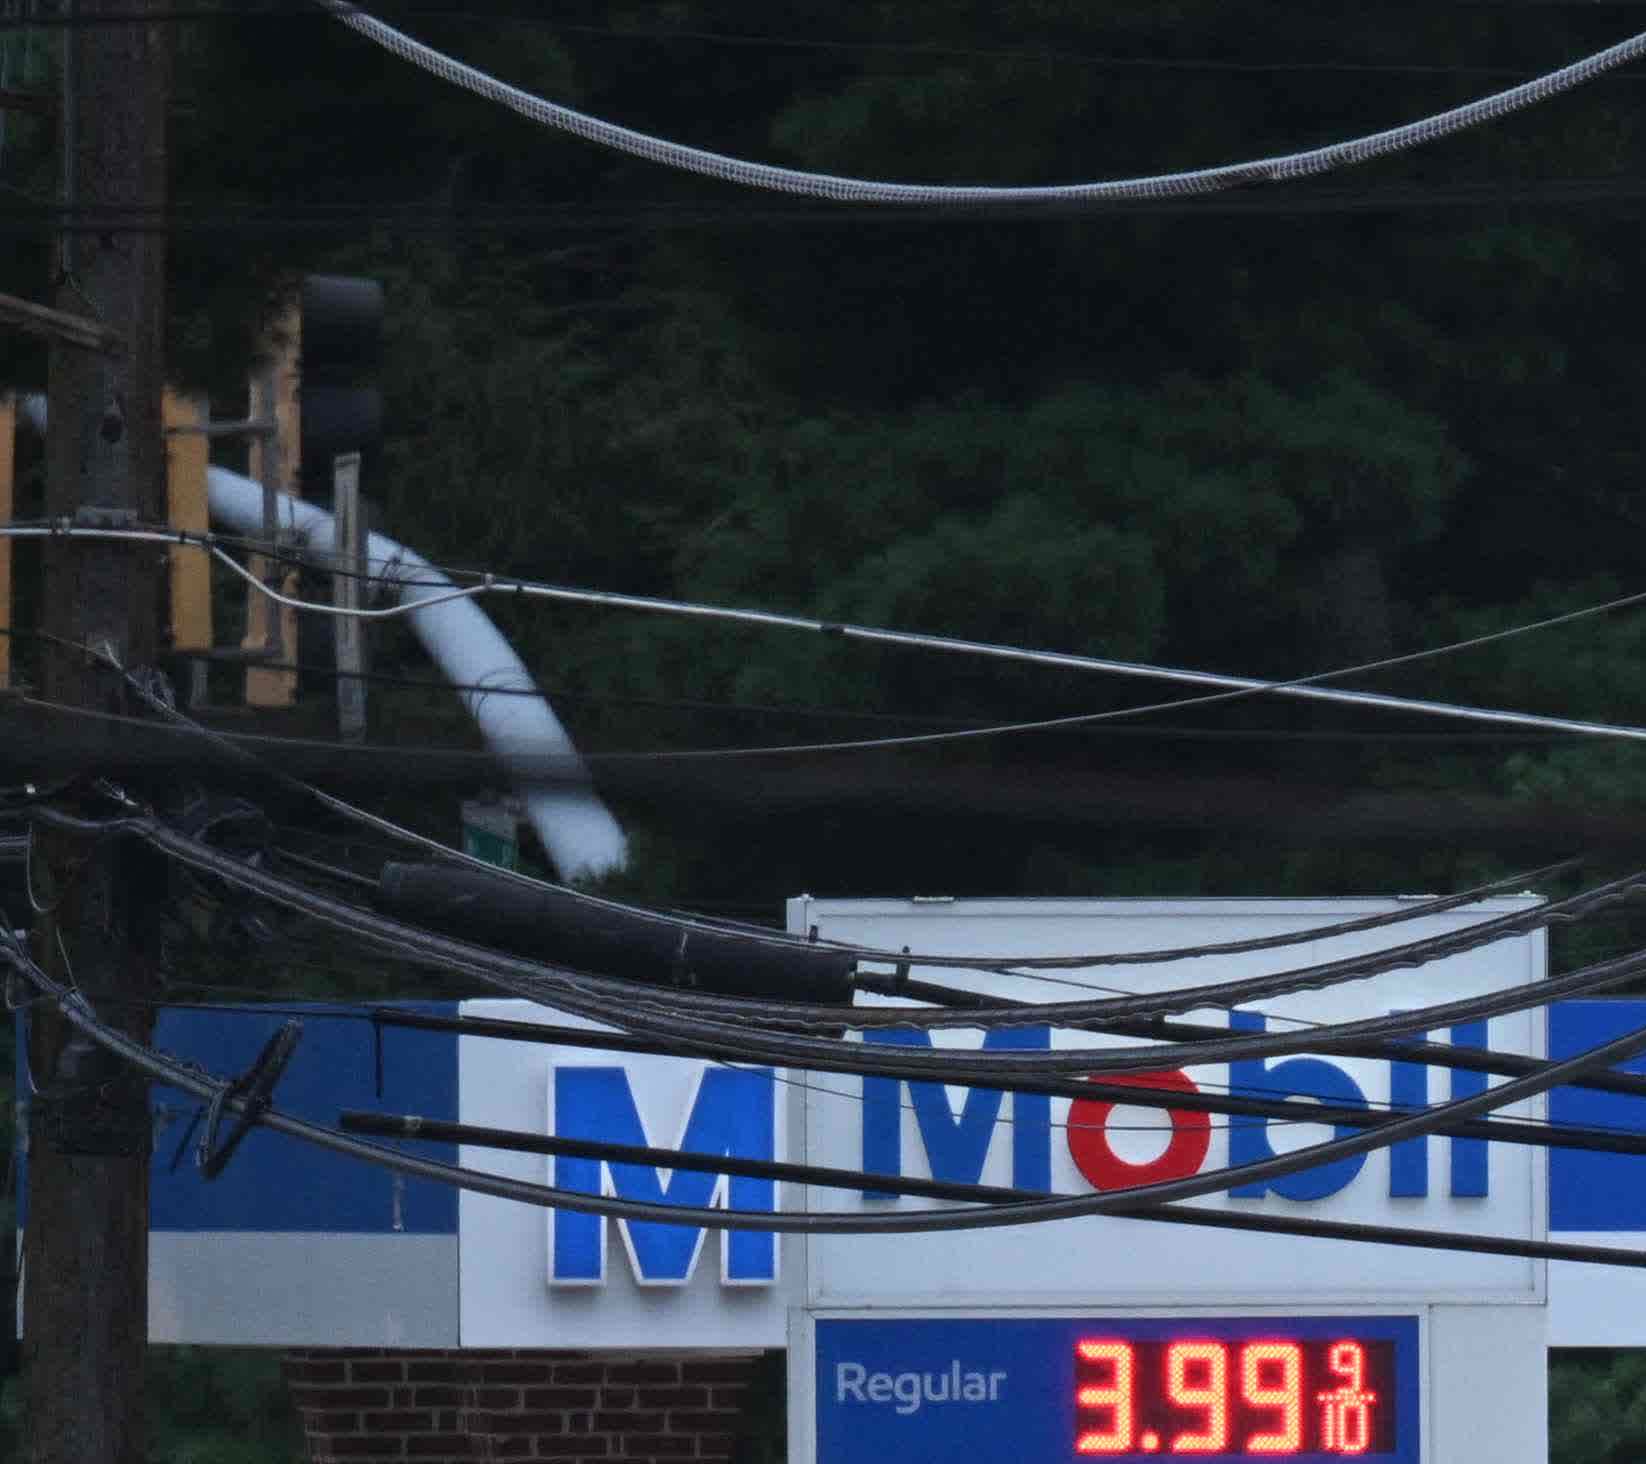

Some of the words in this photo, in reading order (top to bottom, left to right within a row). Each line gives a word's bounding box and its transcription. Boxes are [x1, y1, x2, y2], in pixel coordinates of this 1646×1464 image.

[860, 1008, 1490, 1200] Mobil
[835, 1360, 1007, 1415] Regular
[1074, 1340, 1302, 1455] 3.99
